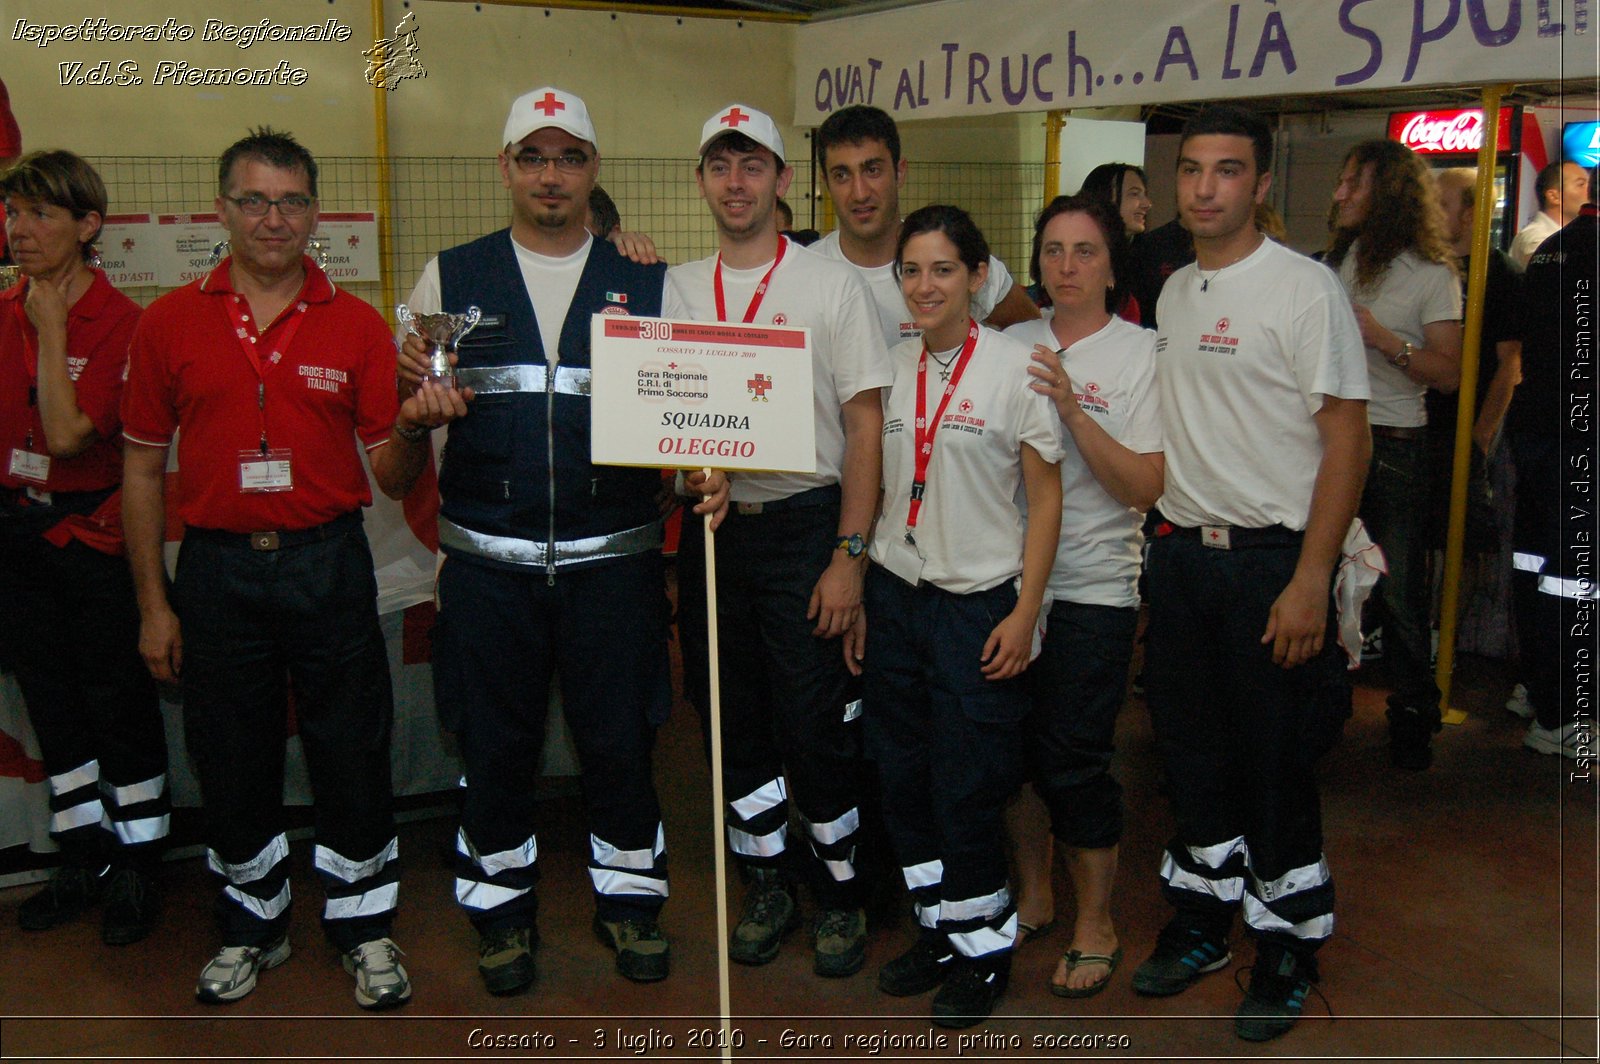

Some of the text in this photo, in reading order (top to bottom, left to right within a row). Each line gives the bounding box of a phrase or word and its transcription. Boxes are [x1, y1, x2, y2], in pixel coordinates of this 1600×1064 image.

[815, 58, 883, 112] QUAT
[894, 60, 929, 110] AL
[120, 272, 154, 282] D'ASTI
[657, 347, 695, 355] COSSATO
[706, 349, 737, 358] LUGLIO
[299, 365, 347, 384] CROCE ROSSA
[638, 370, 708, 382] Gara Regionale
[307, 378, 339, 393] ITALIANA
[638, 379, 672, 388] C.R.I. di
[638, 388, 708, 399] Primo Soccorso
[661, 411, 750, 430] SQUADRA
[658, 437, 755, 458] OLEGGIO
